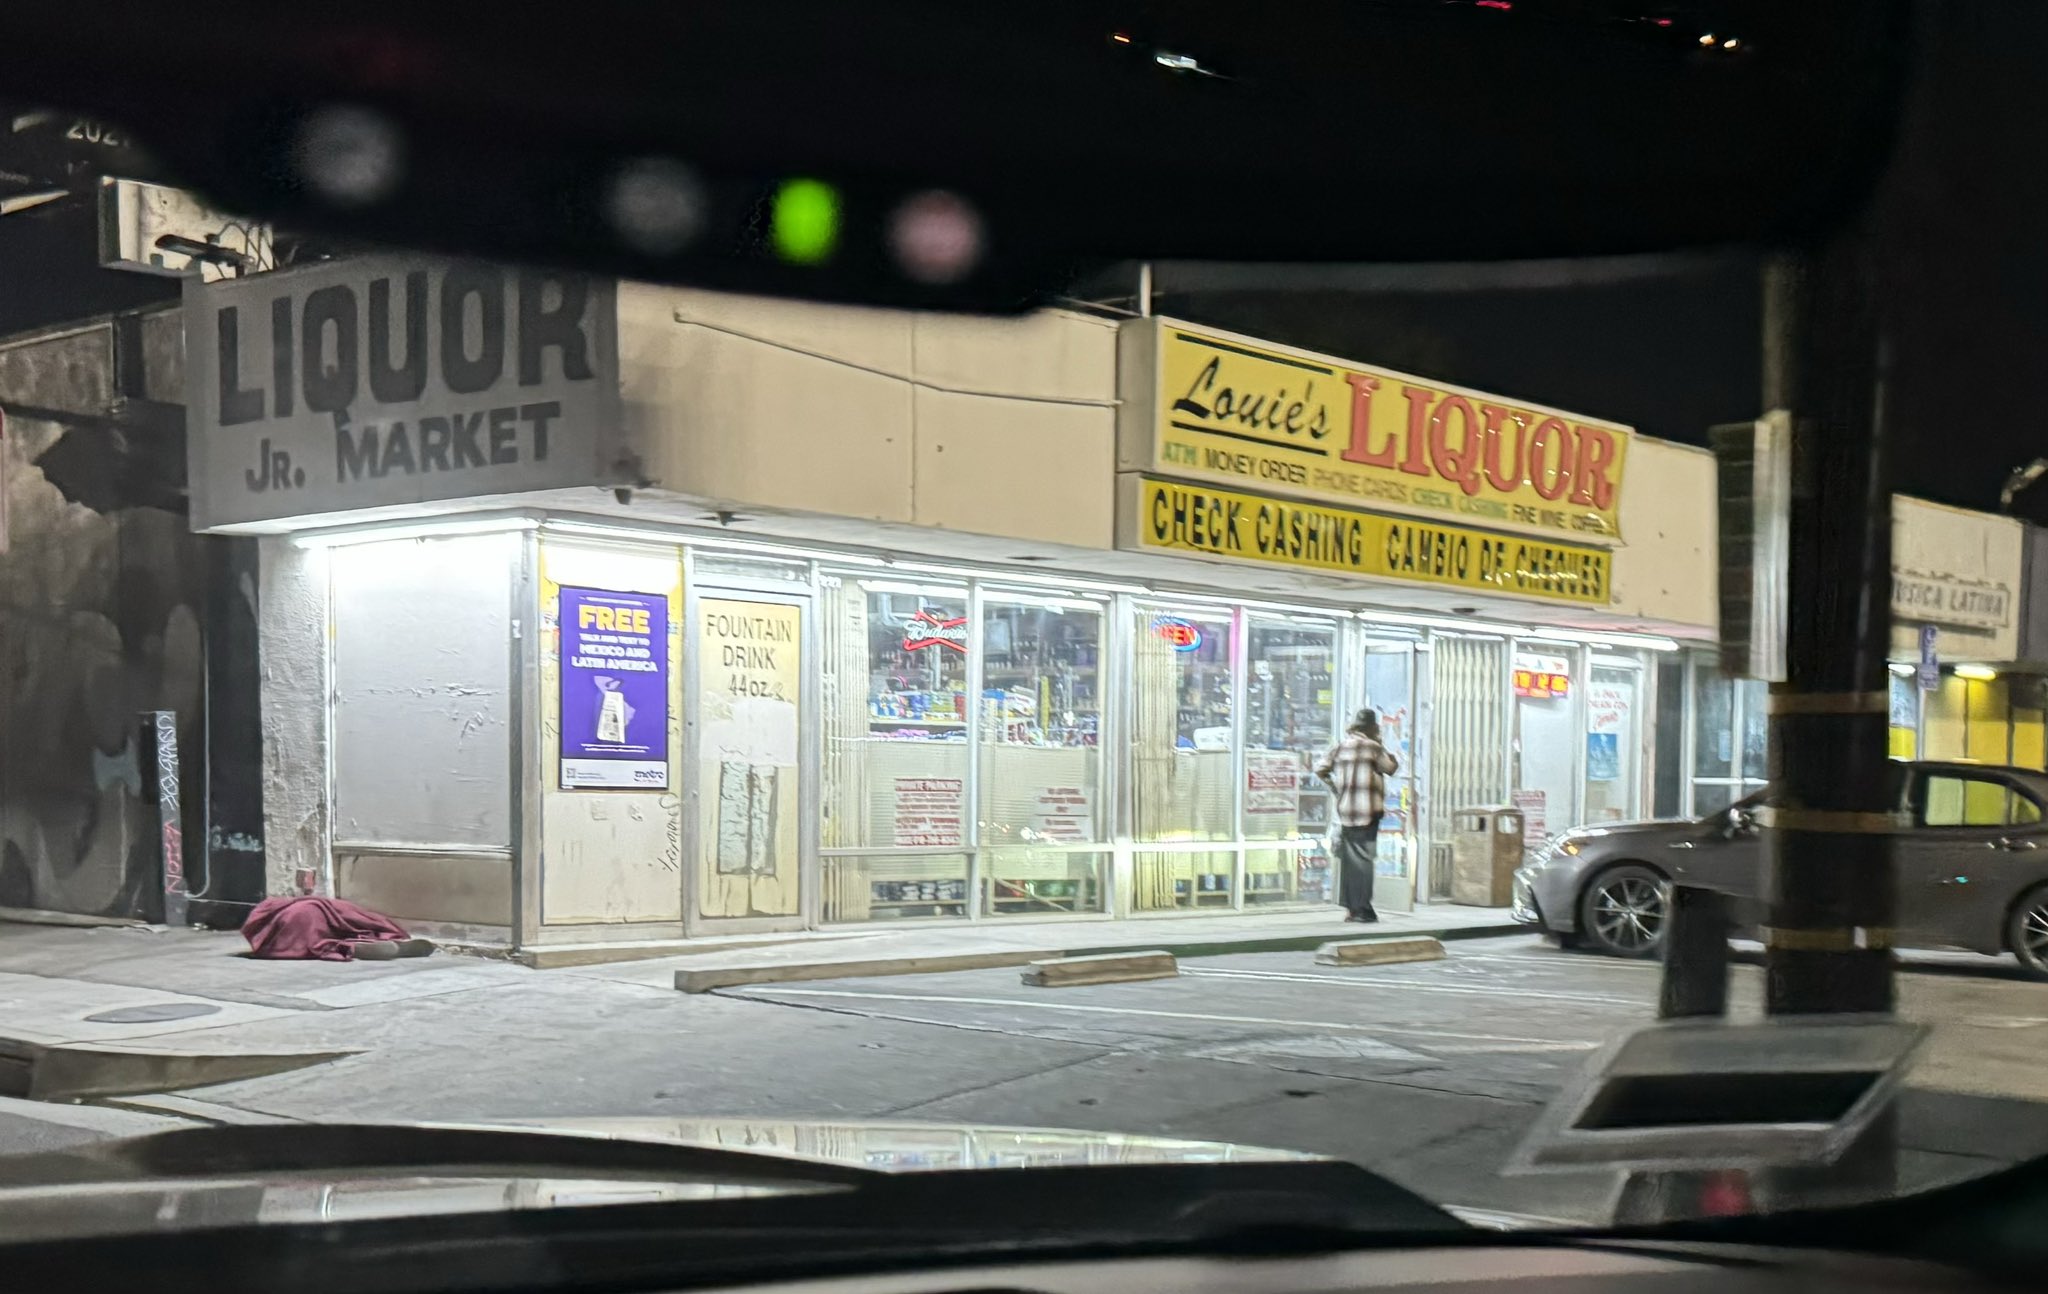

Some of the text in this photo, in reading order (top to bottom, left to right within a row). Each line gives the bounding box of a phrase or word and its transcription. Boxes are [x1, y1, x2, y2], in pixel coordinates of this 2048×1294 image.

[217, 268, 595, 430] LIQUOR
[1172, 355, 1332, 440] Louie's
[336, 401, 561, 484] MARKET
[1162, 441, 1198, 465] ATM
[1205, 447, 1257, 475] MONEY
[1258, 458, 1307, 486] ORDER
[1340, 372, 1614, 511] LIQUOR
[1153, 488, 1602, 599] CHECK CASHING CAMBIO DE CHEQUES
[578, 603, 651, 635] FREE
[706, 613, 792, 642] FOUNTAIN
[722, 644, 777, 670] DRINK
